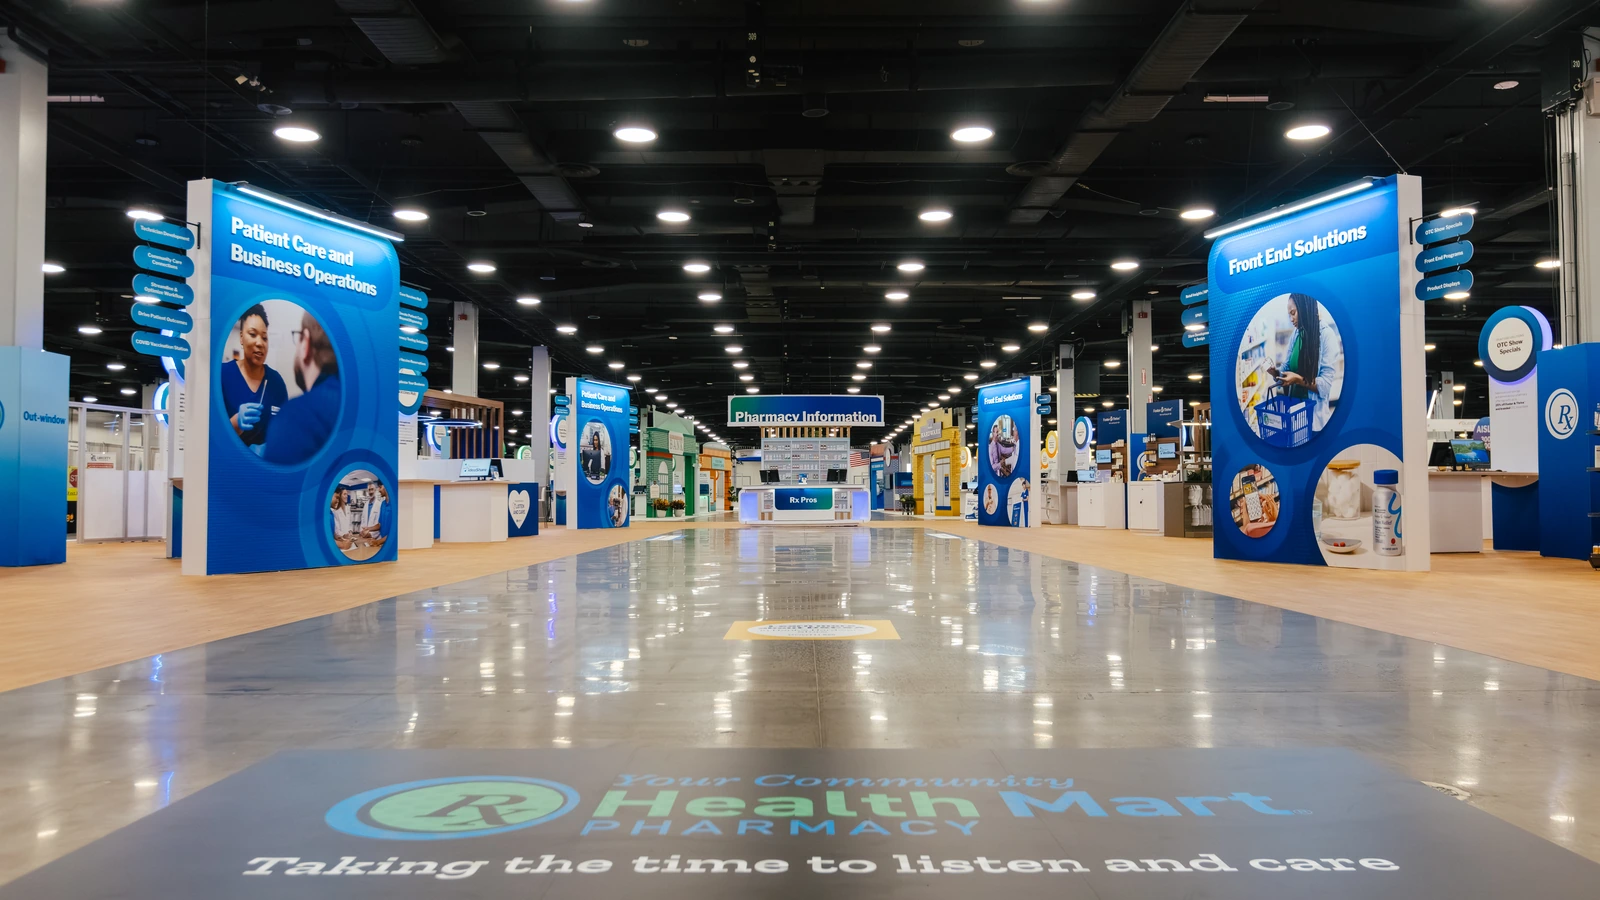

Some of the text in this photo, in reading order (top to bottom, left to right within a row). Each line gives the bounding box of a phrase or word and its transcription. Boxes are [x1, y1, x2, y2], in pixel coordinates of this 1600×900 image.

[1445, 221, 1463, 230] Specials
[140, 225, 190, 242] Technician Development
[231, 216, 354, 267] Patient Care and
[1229, 225, 1367, 276] Front End Solutions
[1443, 251, 1464, 260] Programs
[148, 252, 171, 263] Community
[152, 260, 178, 270] Connections
[230, 242, 377, 296] Business Operations
[144, 286, 184, 299] Optimize Workflow
[151, 282, 173, 291] Streamline
[1427, 281, 1460, 292] Product Displays
[150, 313, 166, 321] Patient
[166, 317, 188, 326] Outcomes
[150, 341, 173, 350] Vaccination
[1499, 346, 1521, 355] Specials
[581, 390, 616, 403] Patient Care and
[983, 393, 1023, 405] Front End Solutions
[581, 400, 600, 411] Business
[600, 403, 623, 413] Operations
[23, 411, 66, 425] Out-window
[735, 410, 877, 423] Pharmacy Information
[1476, 425, 1490, 433] AISL
[70, 474, 78, 482] ST
[613, 773, 1075, 790] Your Community
[592, 789, 980, 818] Health
[580, 819, 980, 836] PHARMACY
[243, 853, 1400, 880] Taking the time to listen and care
